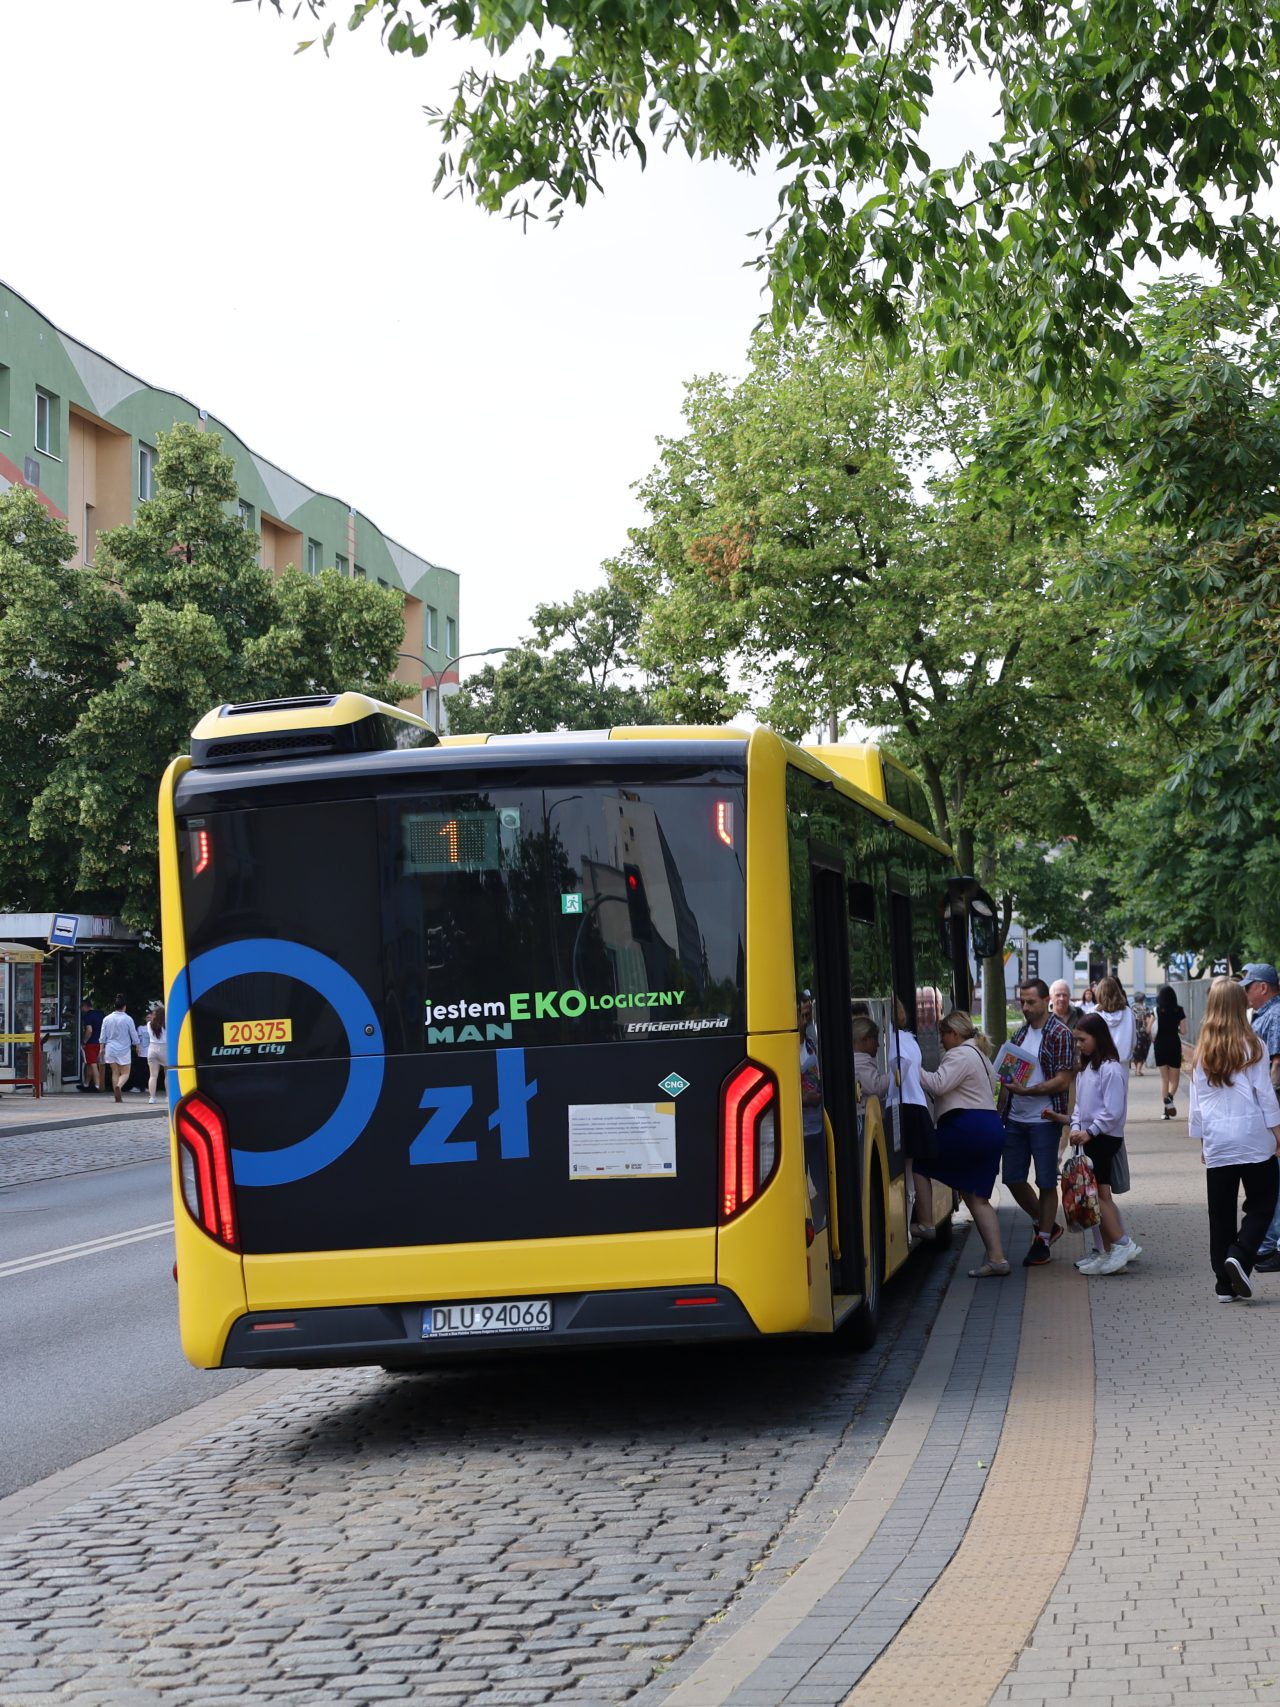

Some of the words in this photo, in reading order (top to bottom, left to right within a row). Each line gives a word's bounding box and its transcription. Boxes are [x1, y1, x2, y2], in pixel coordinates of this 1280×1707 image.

[438, 819, 458, 863] 1
[424, 999, 505, 1025] jestem
[509, 989, 685, 1021] EKOLOGICZNY
[229, 1021, 286, 1043] 20375
[427, 1022, 513, 1045] MAN
[627, 1018, 729, 1033] EfficientHybrid
[211, 1045, 252, 1057] Lion's
[258, 1043, 286, 1055] City
[664, 1080, 684, 1089] CNG
[409, 1048, 538, 1166] zł
[433, 1307, 475, 1331] DLU
[481, 1302, 549, 1328] 94066
